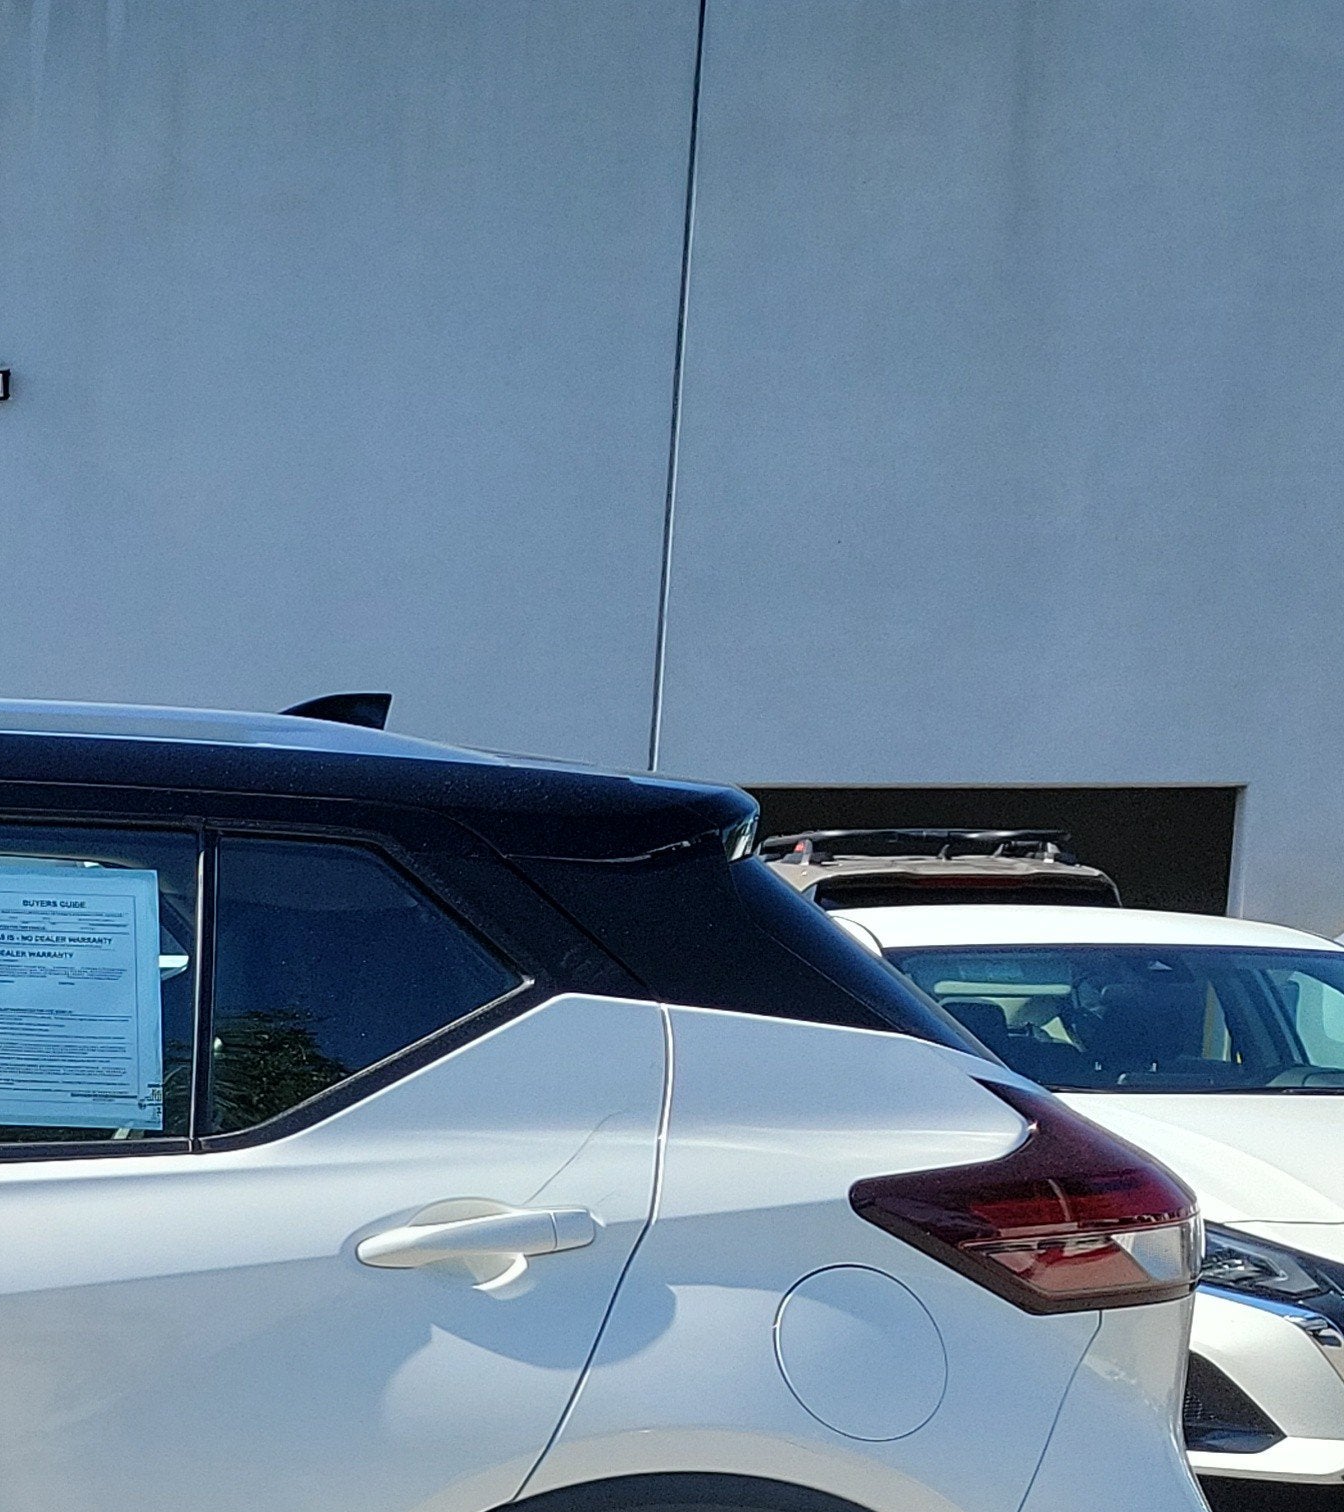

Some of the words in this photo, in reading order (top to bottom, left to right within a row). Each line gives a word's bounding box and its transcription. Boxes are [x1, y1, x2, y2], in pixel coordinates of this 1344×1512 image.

[22, 899, 58, 908] BUYERS
[59, 900, 87, 909] GUIDE
[21, 934, 33, 942] NO
[34, 935, 67, 943] DEALER
[68, 936, 113, 945] WARRANTY
[28, 950, 74, 959] WARRANTY
